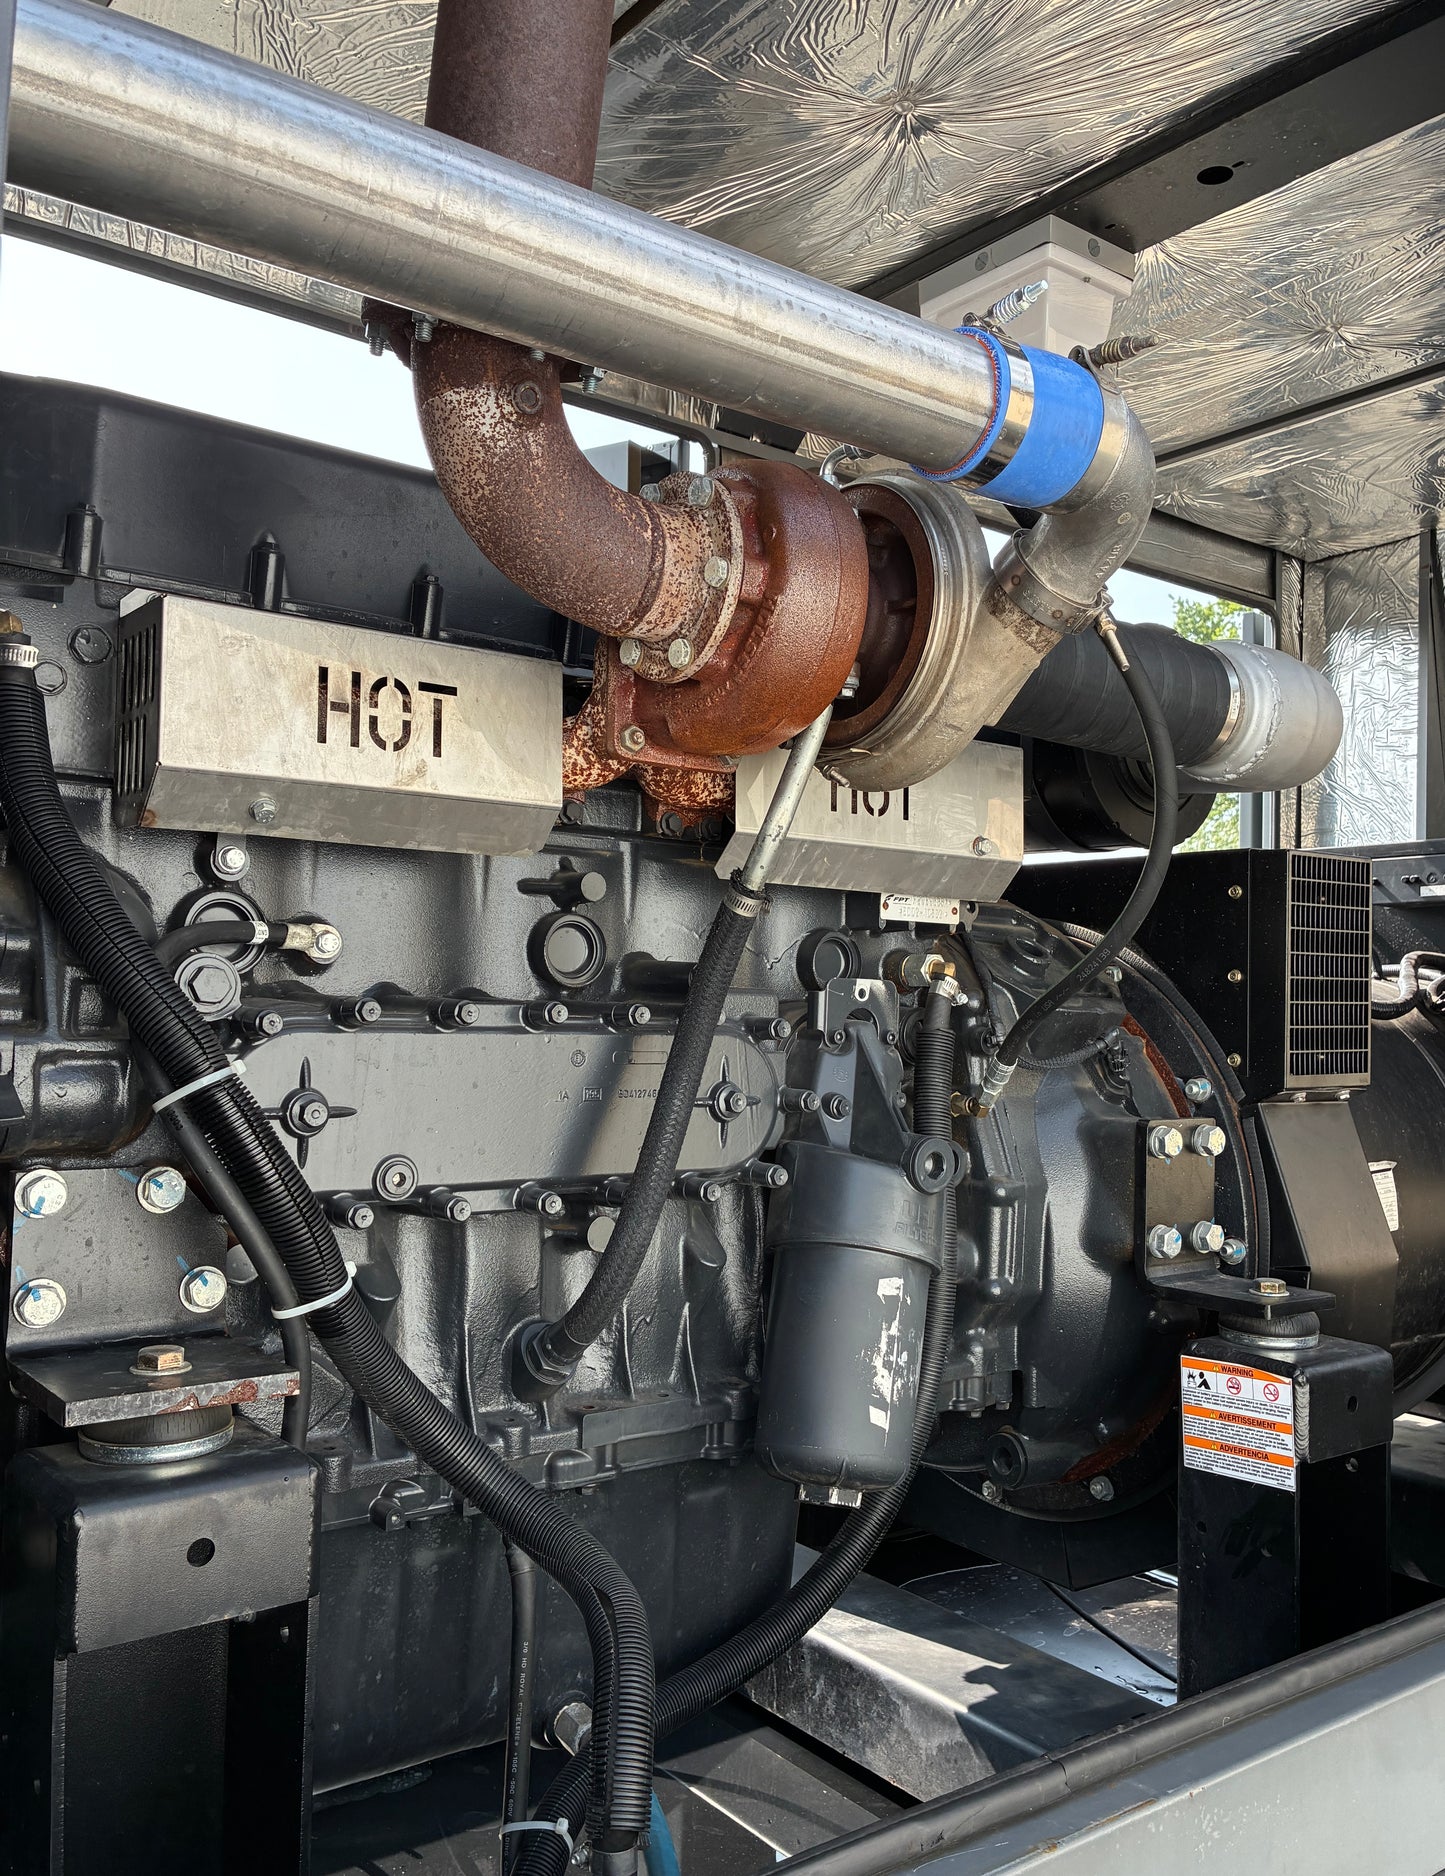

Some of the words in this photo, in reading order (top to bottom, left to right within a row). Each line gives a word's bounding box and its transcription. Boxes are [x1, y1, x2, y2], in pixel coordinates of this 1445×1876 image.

[316, 665, 459, 758] HOT
[1220, 1365, 1254, 1378] WARNING
[1218, 1412, 1277, 1430] AVERTISSEMENT
[1219, 1443, 1270, 1461] ADVERTENCIA
[521, 1657, 527, 1668] HD
[518, 1673, 526, 1696] ROYAL
